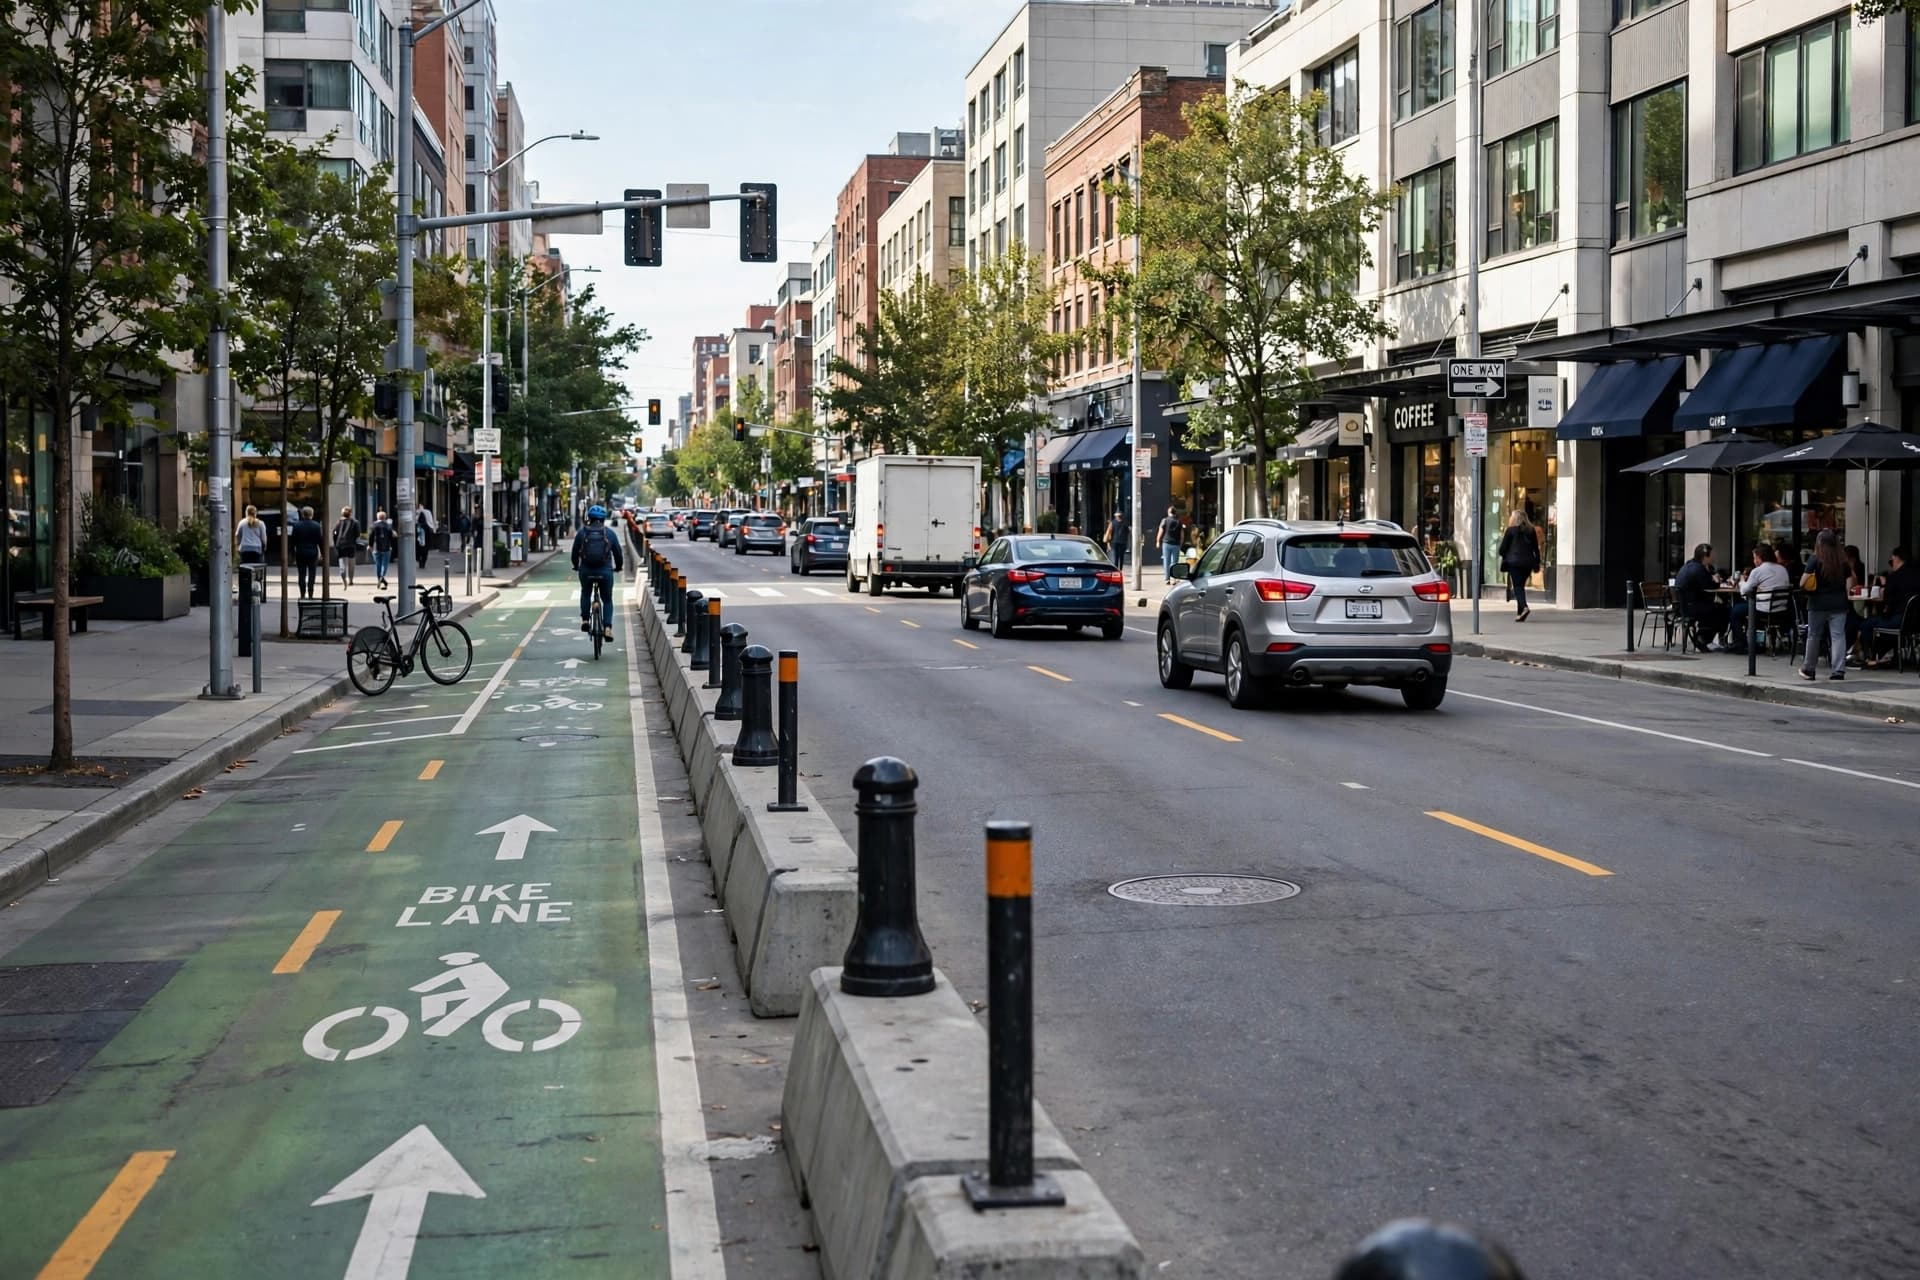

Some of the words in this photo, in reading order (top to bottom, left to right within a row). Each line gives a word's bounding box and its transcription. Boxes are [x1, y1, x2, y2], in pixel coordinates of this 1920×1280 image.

[1453, 365, 1473, 376] ONE
[1480, 365, 1500, 376] WAY
[1394, 403, 1434, 430] COFFEE
[418, 882, 552, 904] BIKE
[395, 901, 573, 927] LANE
